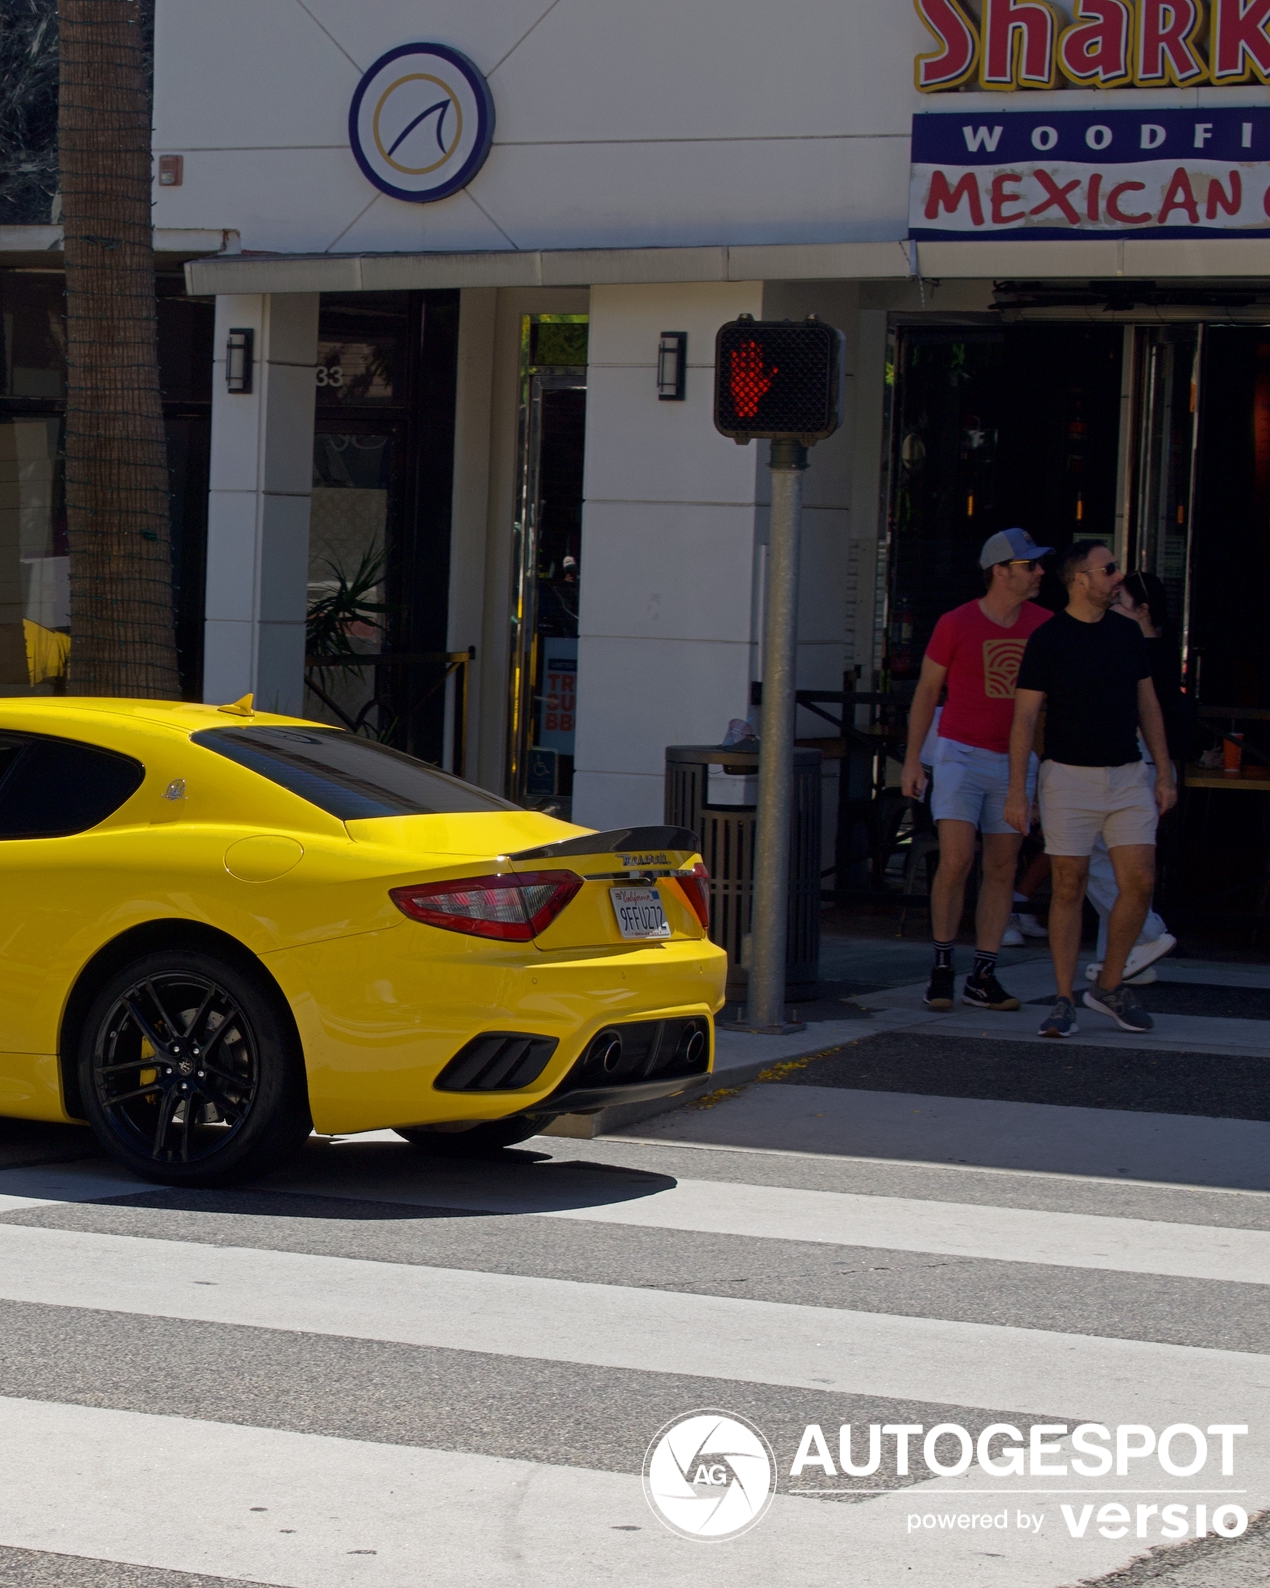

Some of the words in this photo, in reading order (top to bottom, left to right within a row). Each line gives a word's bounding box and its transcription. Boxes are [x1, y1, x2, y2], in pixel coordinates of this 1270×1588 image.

[962, 122, 1253, 152] WOODFI
[924, 167, 1243, 226] MEXICAN
[547, 673, 577, 692] TR
[545, 713, 575, 731] BB
[620, 906, 667, 931] 9FFU272
